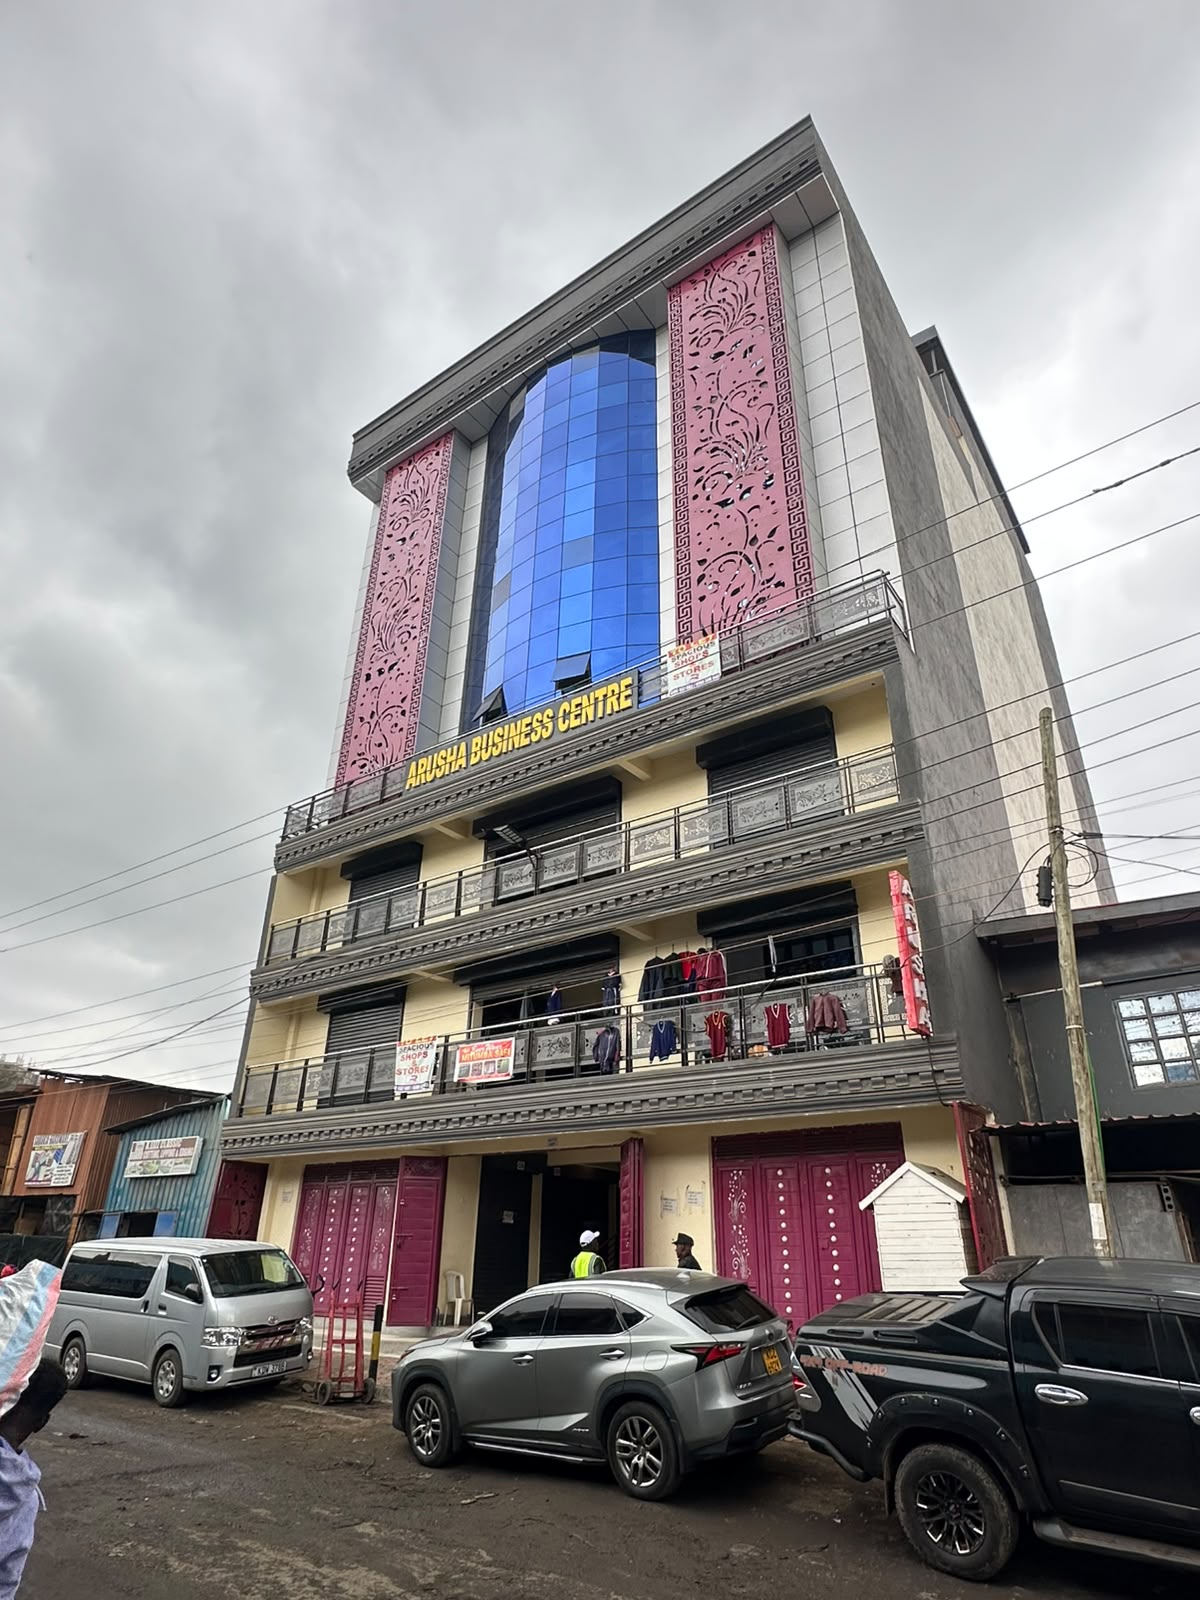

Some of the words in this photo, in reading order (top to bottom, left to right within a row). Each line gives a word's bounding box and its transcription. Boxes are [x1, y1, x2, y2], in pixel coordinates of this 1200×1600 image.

[671, 641, 716, 663] SPACIOUS
[674, 649, 710, 668] SHOPS
[673, 661, 714, 680] STORES
[405, 741, 467, 790] ARUSHA
[470, 708, 554, 767] BUSINESS
[557, 676, 633, 733] CENTRE
[400, 1042, 435, 1053] SPACIOUS
[400, 1051, 429, 1062] SHOPS
[824, 1356, 888, 1377] OFF-ROAD
